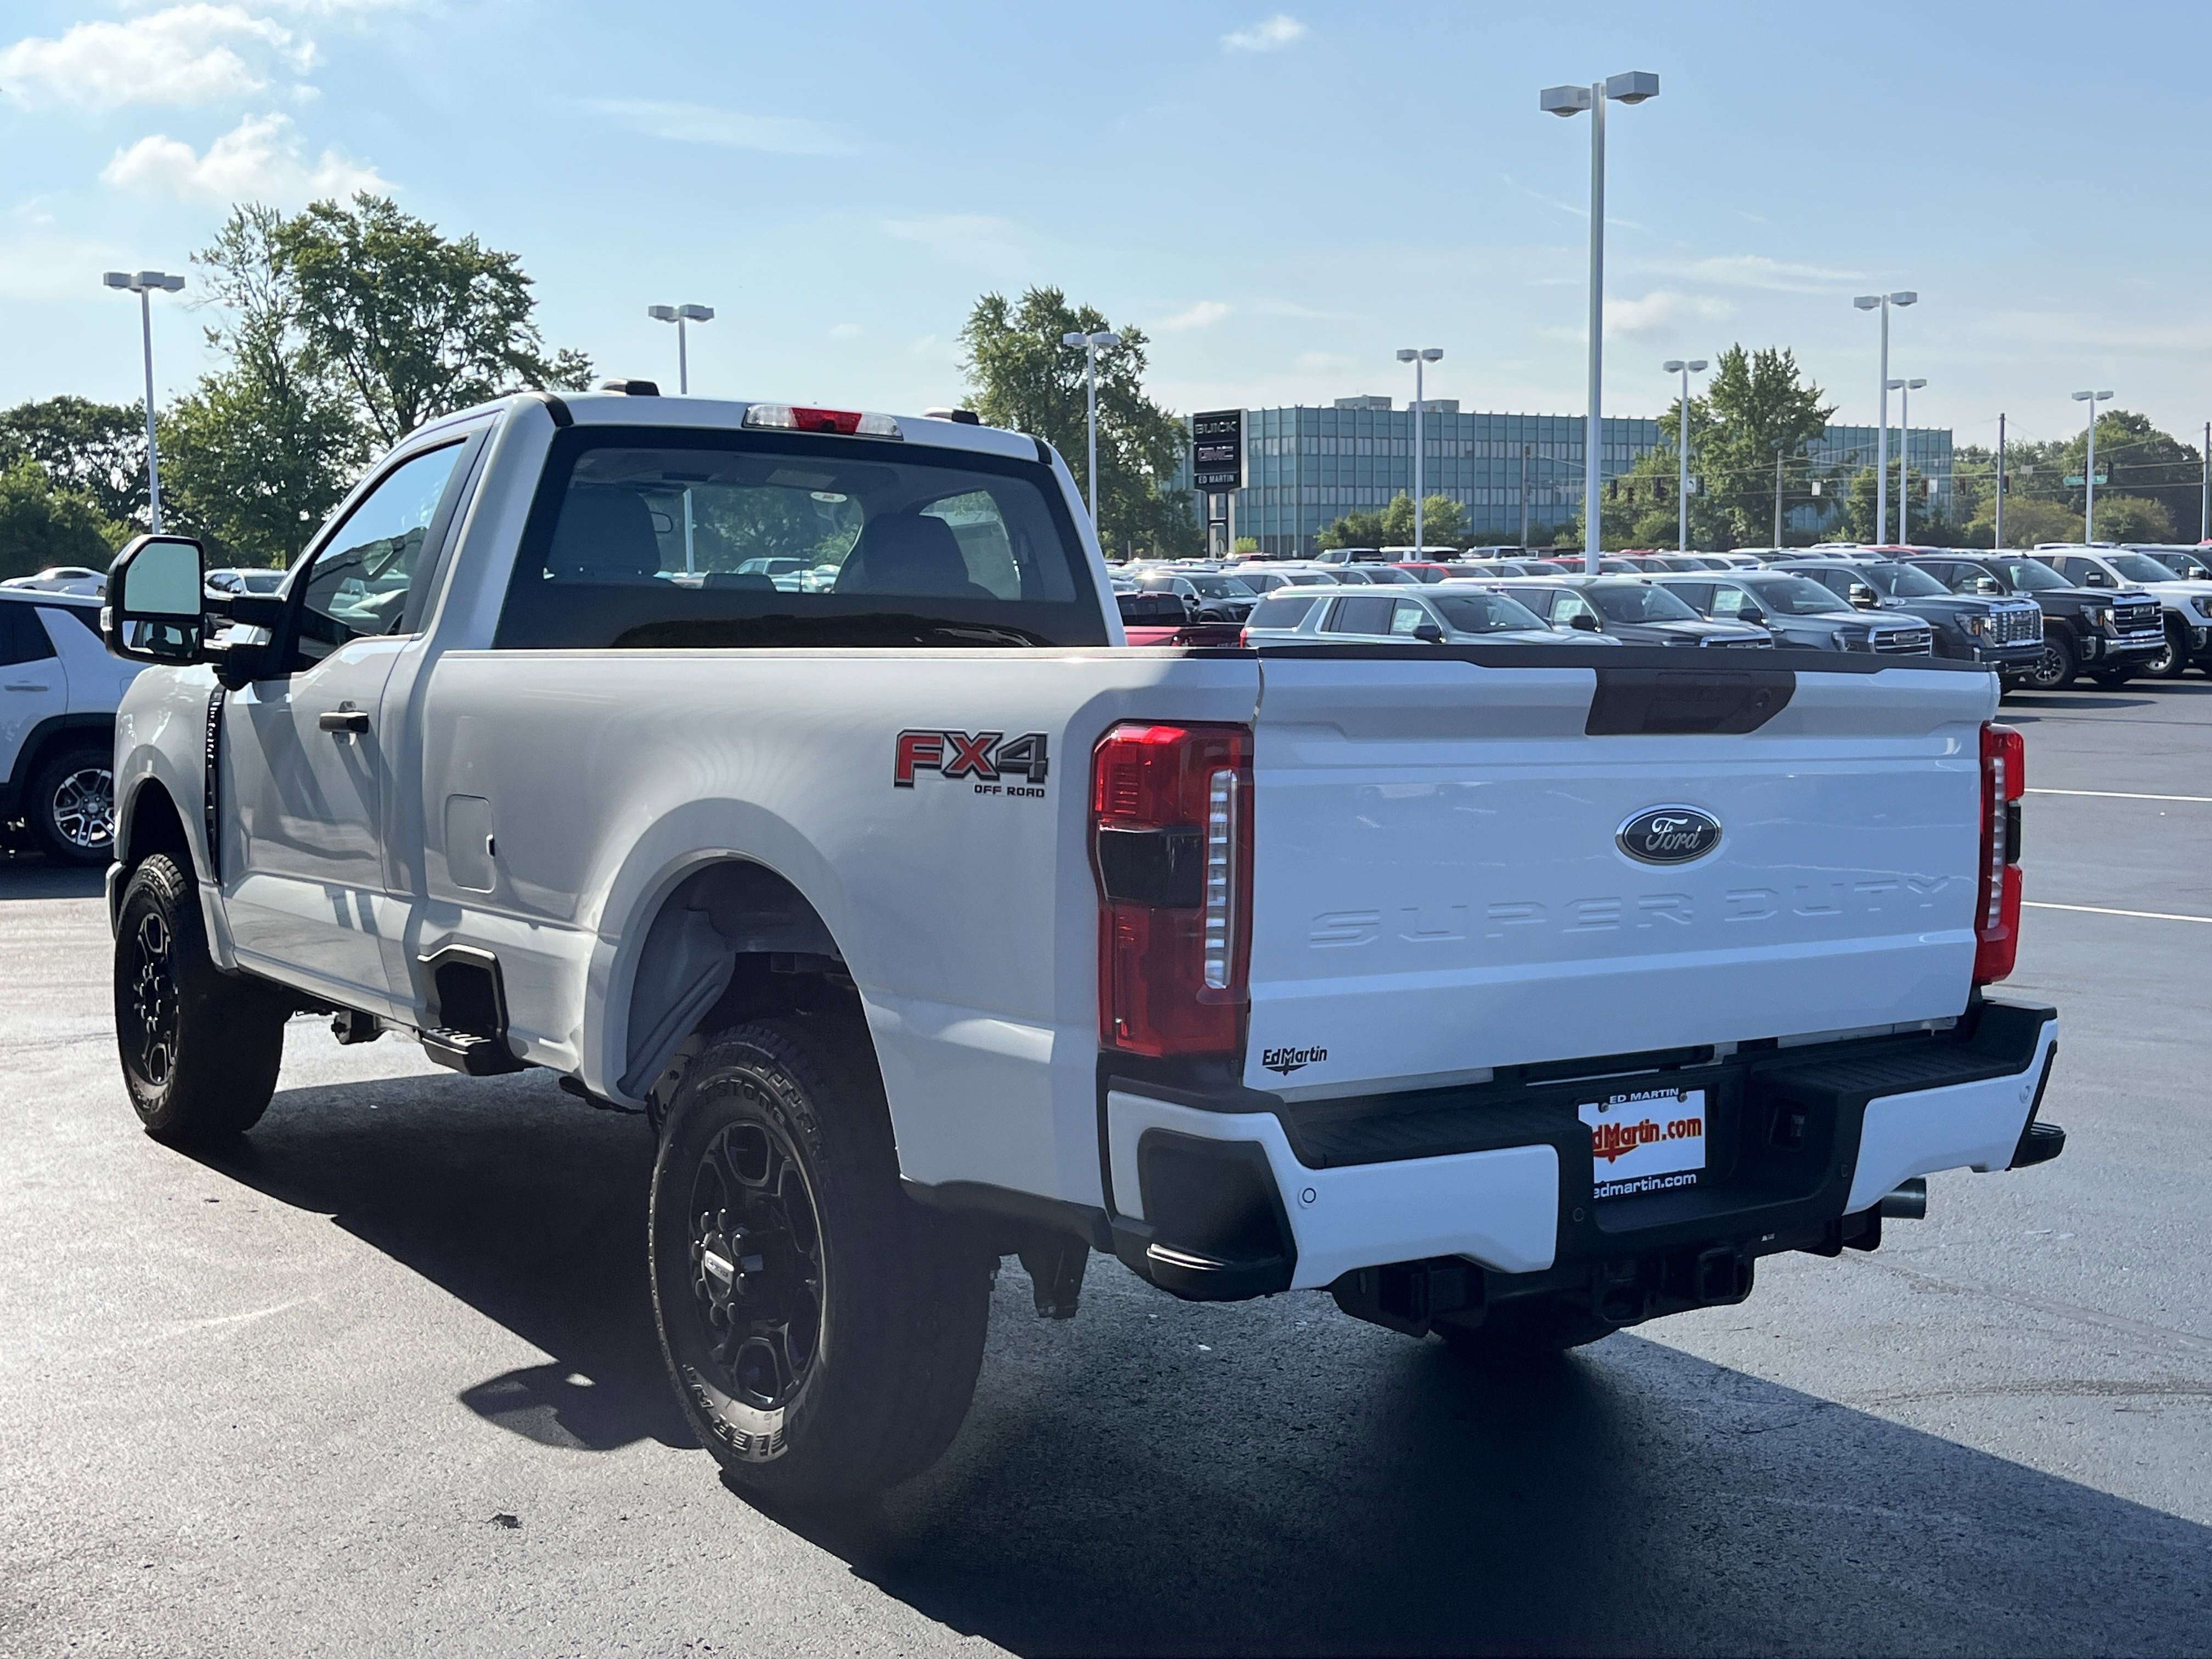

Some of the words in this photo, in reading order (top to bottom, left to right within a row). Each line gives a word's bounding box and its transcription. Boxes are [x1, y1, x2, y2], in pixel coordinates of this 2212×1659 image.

[1195, 421, 1237, 435] BUICK
[1198, 445, 1234, 461] GMC
[1198, 475, 1207, 484] ED
[1209, 474, 1234, 483] MARTIN
[894, 727, 1049, 788] FX4
[974, 785, 1002, 795] OFF
[1007, 786, 1045, 798] ROAD
[1645, 817, 1702, 851] Ford
[1308, 892, 1694, 949] SUPER
[1724, 876, 1950, 922] DUTY
[1262, 1045, 1328, 1065] EdMartin
[1609, 1094, 1627, 1104] ED
[1630, 1087, 1680, 1102] MARTIN
[1593, 1118, 1702, 1149] dMartin.com
[1593, 1173, 1697, 1199] edmartin.com
